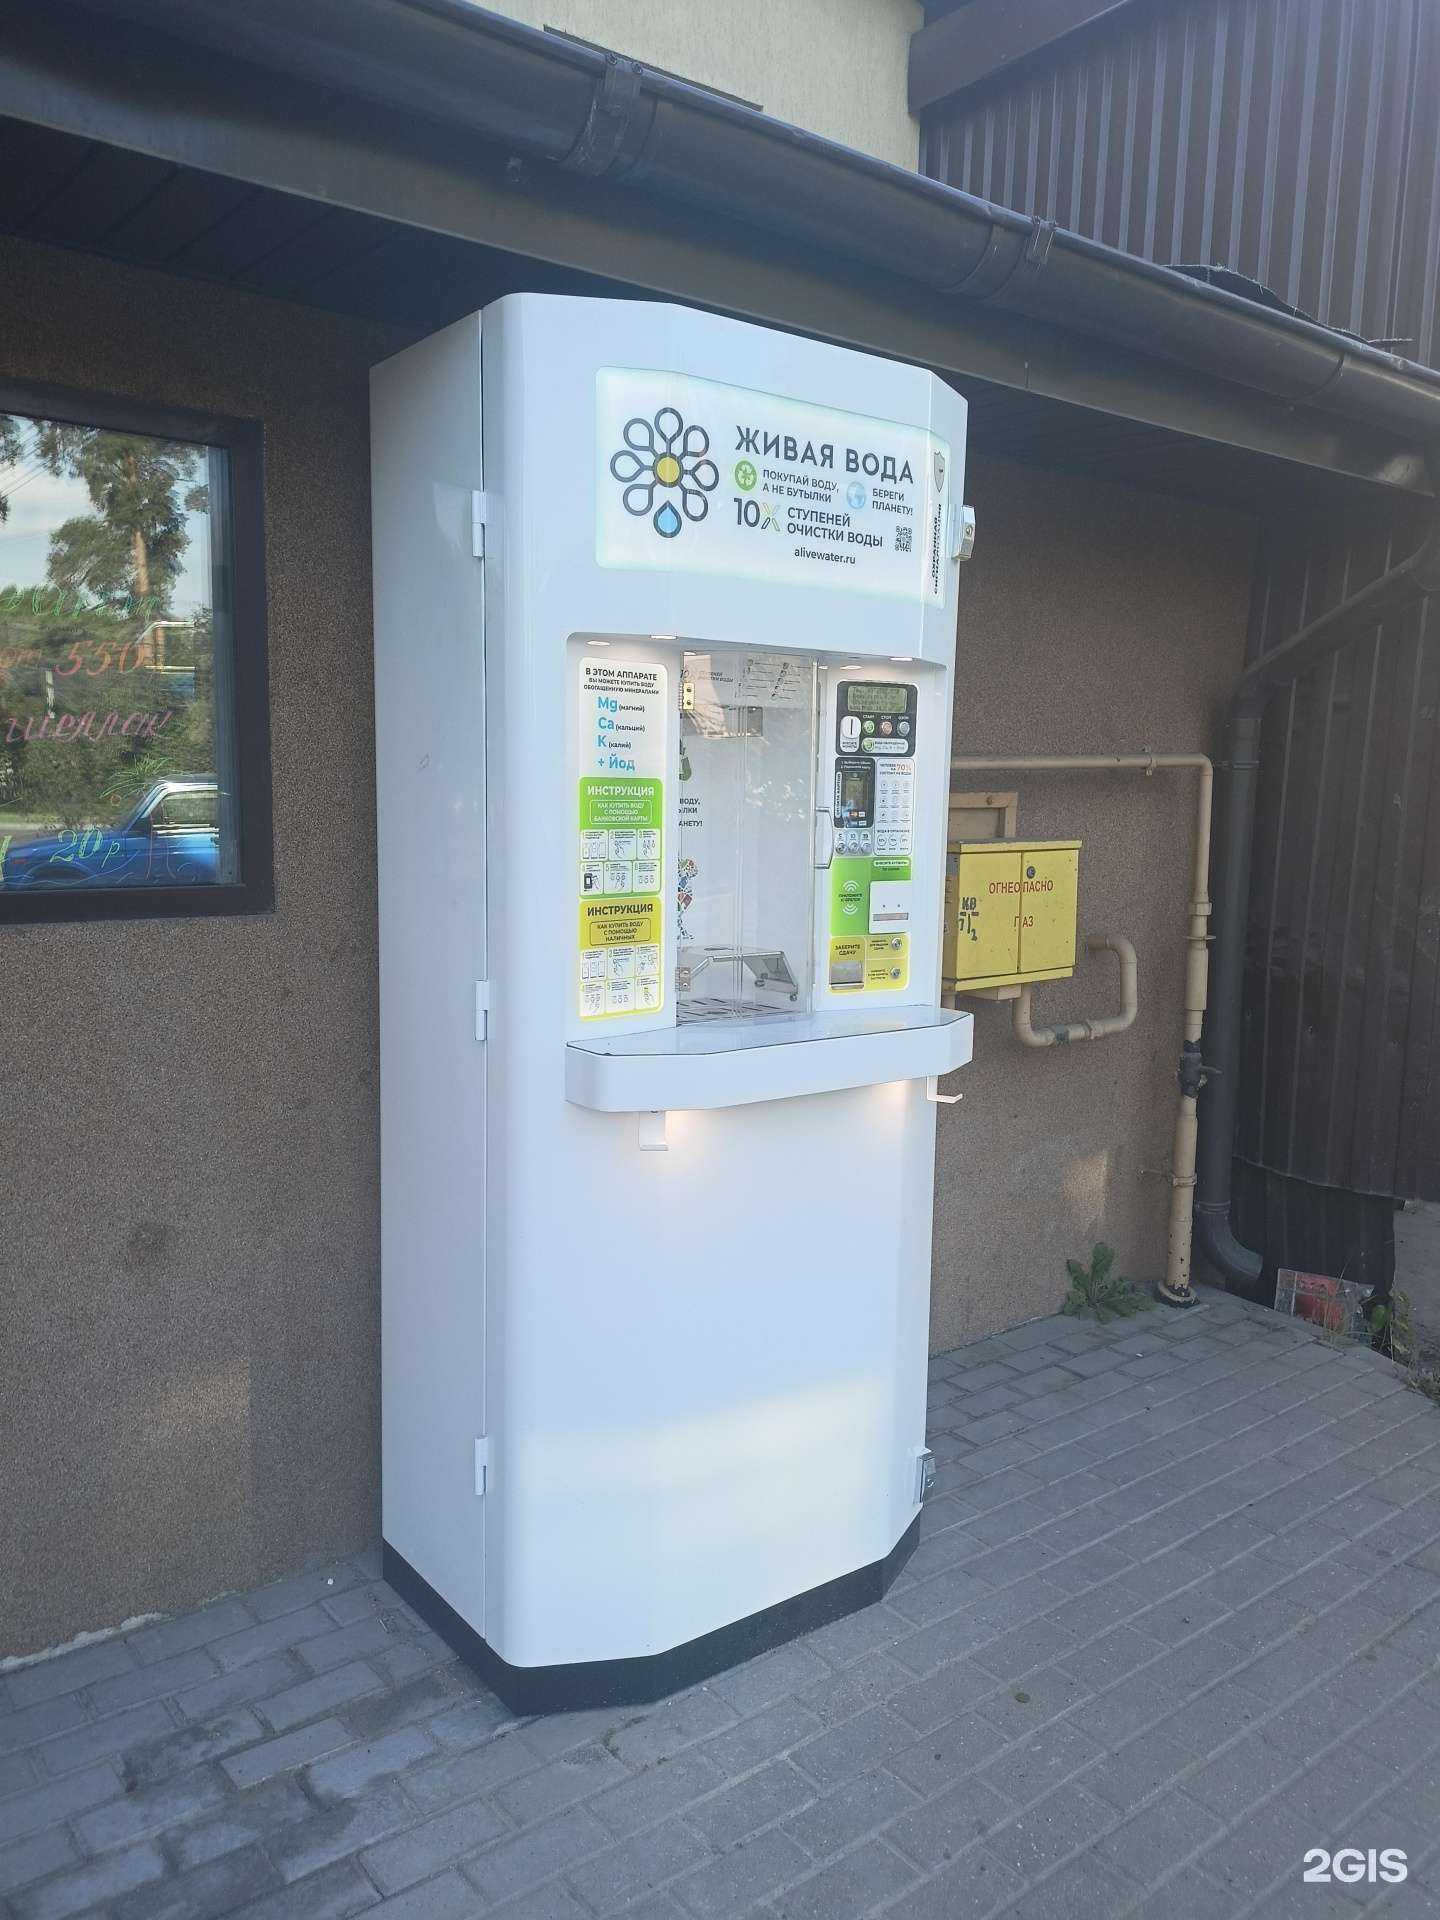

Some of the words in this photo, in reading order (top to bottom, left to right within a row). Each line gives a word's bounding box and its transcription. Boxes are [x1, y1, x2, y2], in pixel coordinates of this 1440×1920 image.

[735, 425, 834, 469] ЖИВАЯ
[845, 448, 914, 484] ВОДА
[763, 469, 809, 486] ПОКУПАЙ
[811, 479, 839, 493] ВОДУ,
[762, 483, 770, 492] А
[772, 485, 785, 495] НЕ
[787, 487, 832, 503] БУТЫЛКИ
[872, 488, 905, 501] БЕРЕГИ
[872, 501, 913, 516] ПЛАНЕТУ!
[787, 507, 851, 527] СТУПЕНЕЙ
[787, 523, 844, 542] ОЧИСТКИ
[847, 532, 883, 547] ВОДЫ
[794, 547, 856, 564] alivewater.ru
[585, 667, 591, 675] В
[593, 668, 615, 677] ЭТОМ
[617, 670, 658, 681] АППАРАТЕ
[598, 696, 618, 712] Mg
[618, 704, 645, 712] (магний)
[615, 723, 645, 733] (кальций)
[608, 741, 632, 750] (калий)
[609, 752, 636, 771] Йод
[587, 785, 655, 797] ИНСТРУКЦИЯ
[989, 880, 1054, 894] ОГНЕОПАСНО
[587, 903, 654, 917] ИНСТРУКЦИЯ
[1014, 915, 1034, 928] ГАЗ
